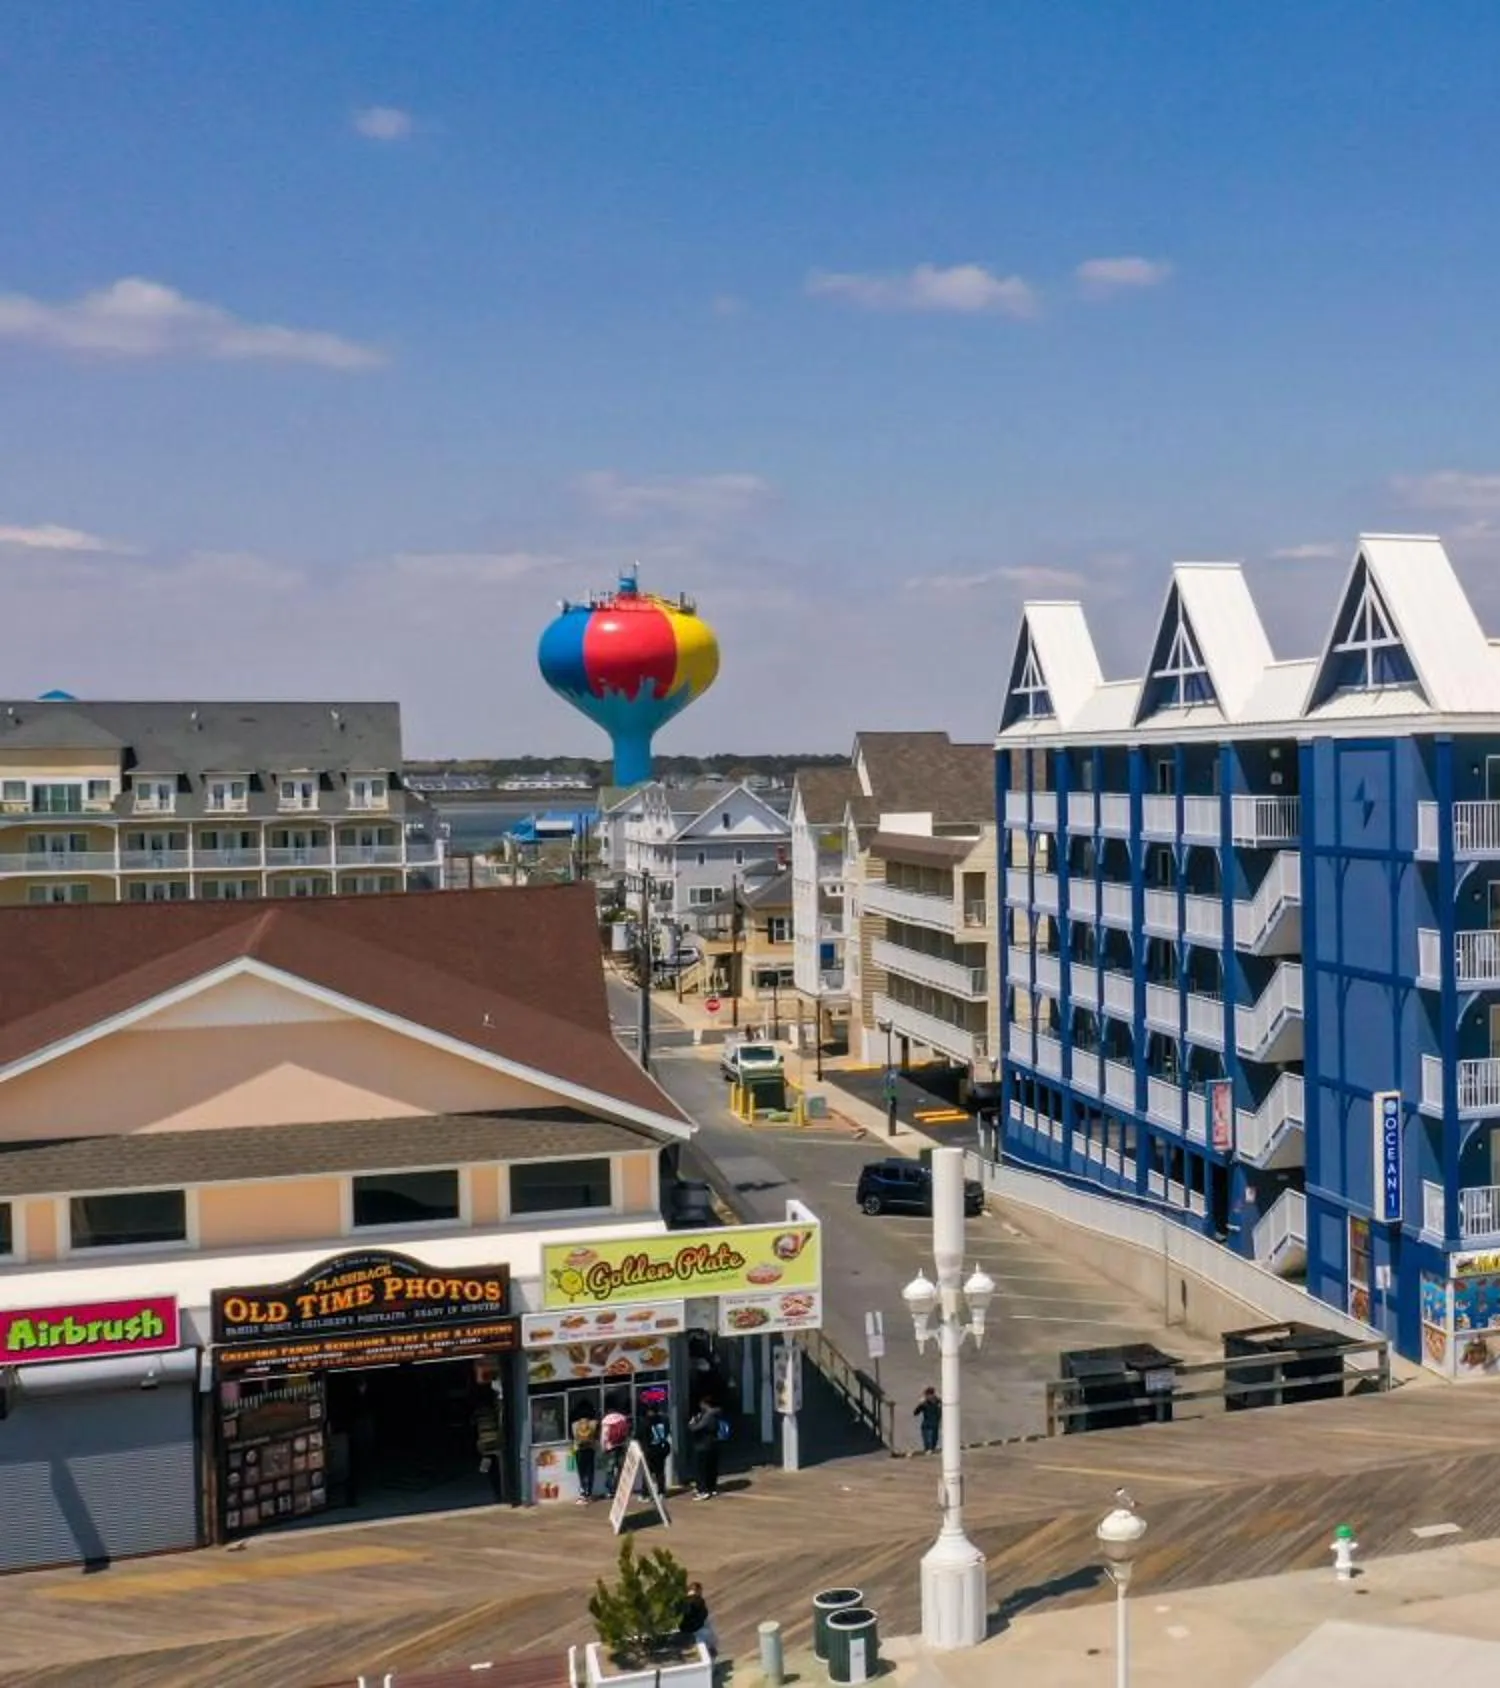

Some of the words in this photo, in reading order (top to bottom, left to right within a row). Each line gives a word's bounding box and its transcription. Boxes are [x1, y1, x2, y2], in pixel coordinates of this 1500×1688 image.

[1385, 1117, 1397, 1190] OCEAN
[314, 1264, 393, 1292] FLASHBACK
[586, 1252, 674, 1301] Golden
[675, 1241, 746, 1281] Plate
[223, 1297, 289, 1323] OLD
[296, 1283, 375, 1319] TIME
[384, 1277, 501, 1302] PHOTOS
[7, 1309, 163, 1351] Airbrush
